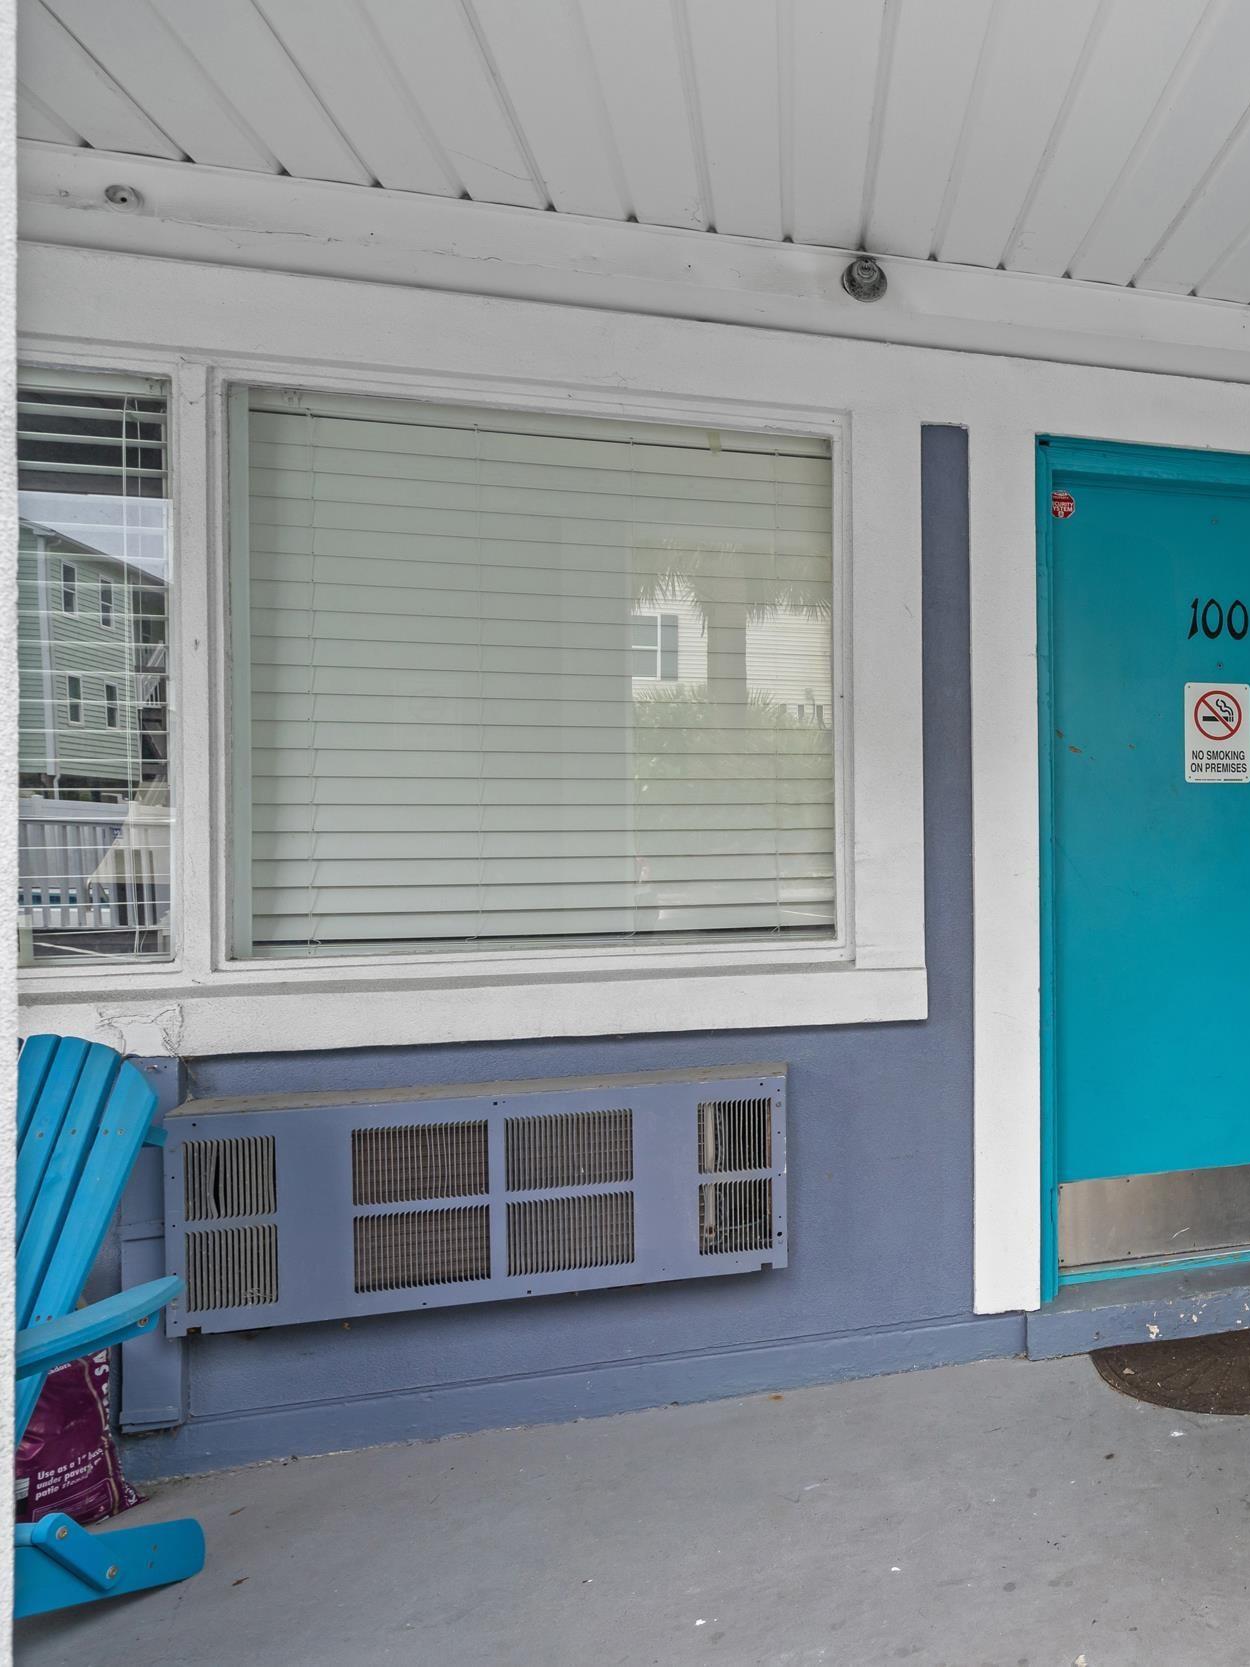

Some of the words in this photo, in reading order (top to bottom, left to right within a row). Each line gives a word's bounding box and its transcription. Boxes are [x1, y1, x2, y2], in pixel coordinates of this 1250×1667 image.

[1188, 598, 1249, 640] 100
[1192, 750, 1204, 760] NO
[1206, 750, 1245, 761] SMOKING
[1190, 762, 1203, 773] ON
[1205, 762, 1247, 773] PREMISES
[37, 1470, 55, 1480] Use
[57, 1464, 68, 1474] as
[69, 1461, 75, 1469] a
[36, 1476, 62, 1490] under
[35, 1485, 60, 1501] patio
